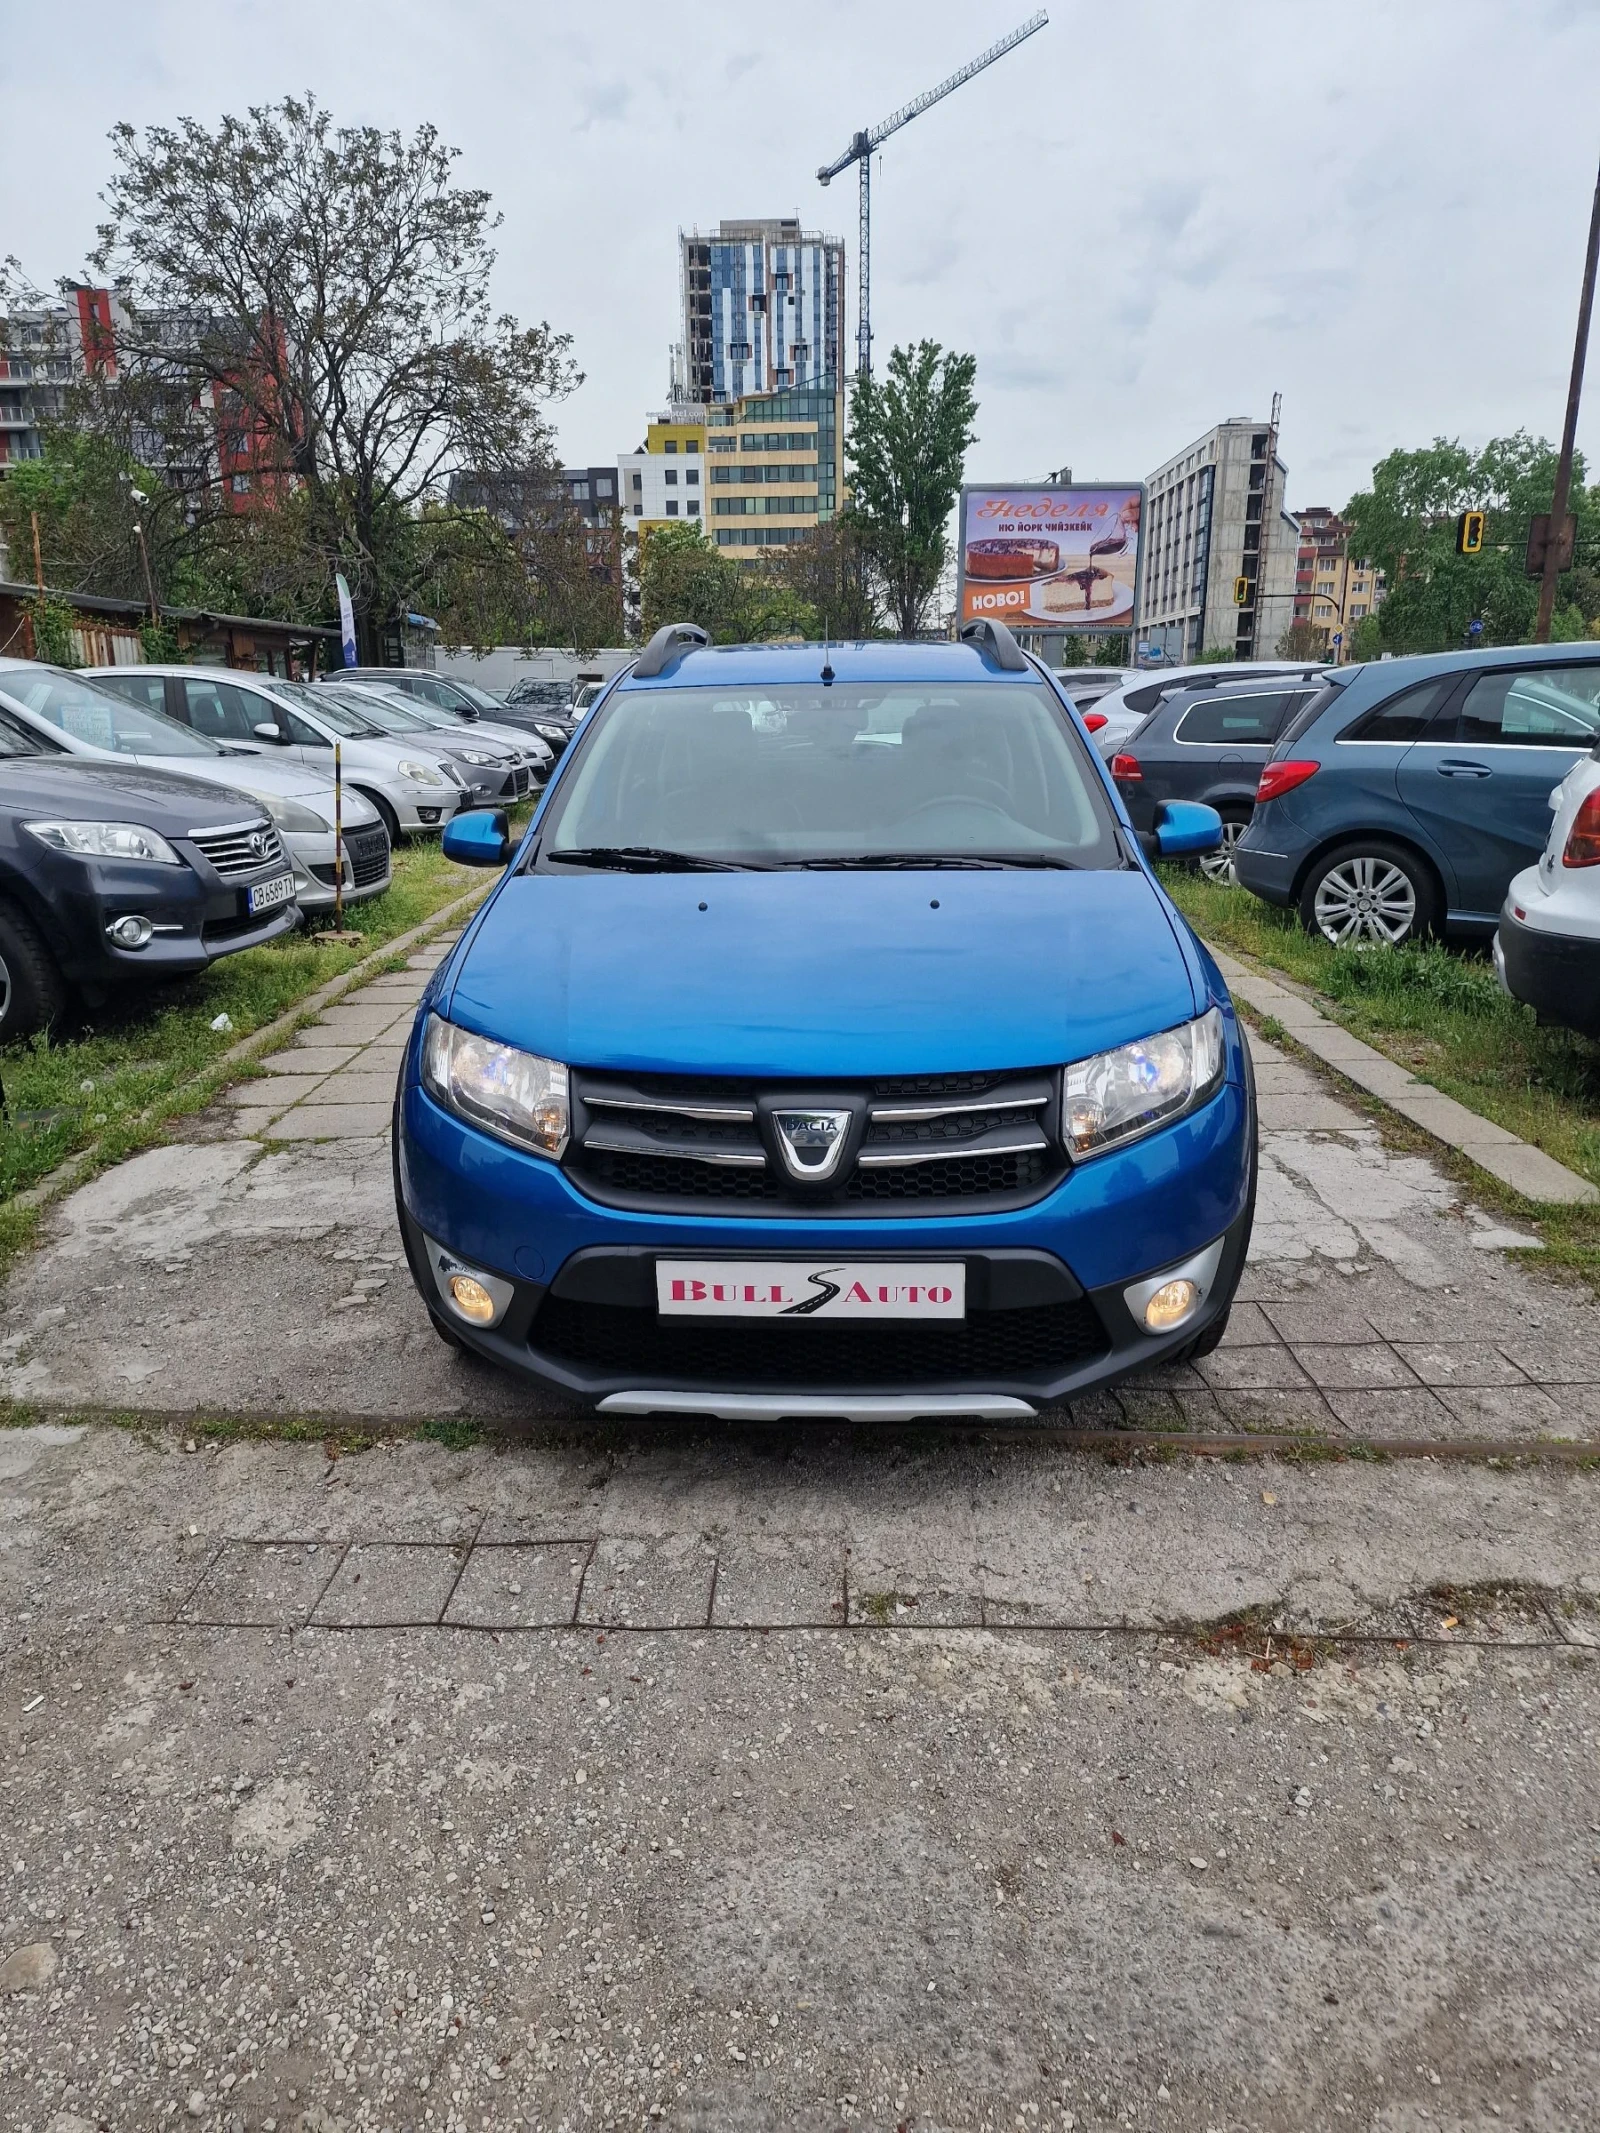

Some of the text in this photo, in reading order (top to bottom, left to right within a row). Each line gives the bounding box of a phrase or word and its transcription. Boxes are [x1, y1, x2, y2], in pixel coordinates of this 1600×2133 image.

[976, 497, 1109, 519] Неделя
[998, 521, 1093, 532] НЮ ЙОРК ЧИЙЗКЕЙК
[972, 590, 1025, 610] НОВО!
[786, 1121, 837, 1131] DACIA
[668, 1279, 953, 1304] BULL AUTO
